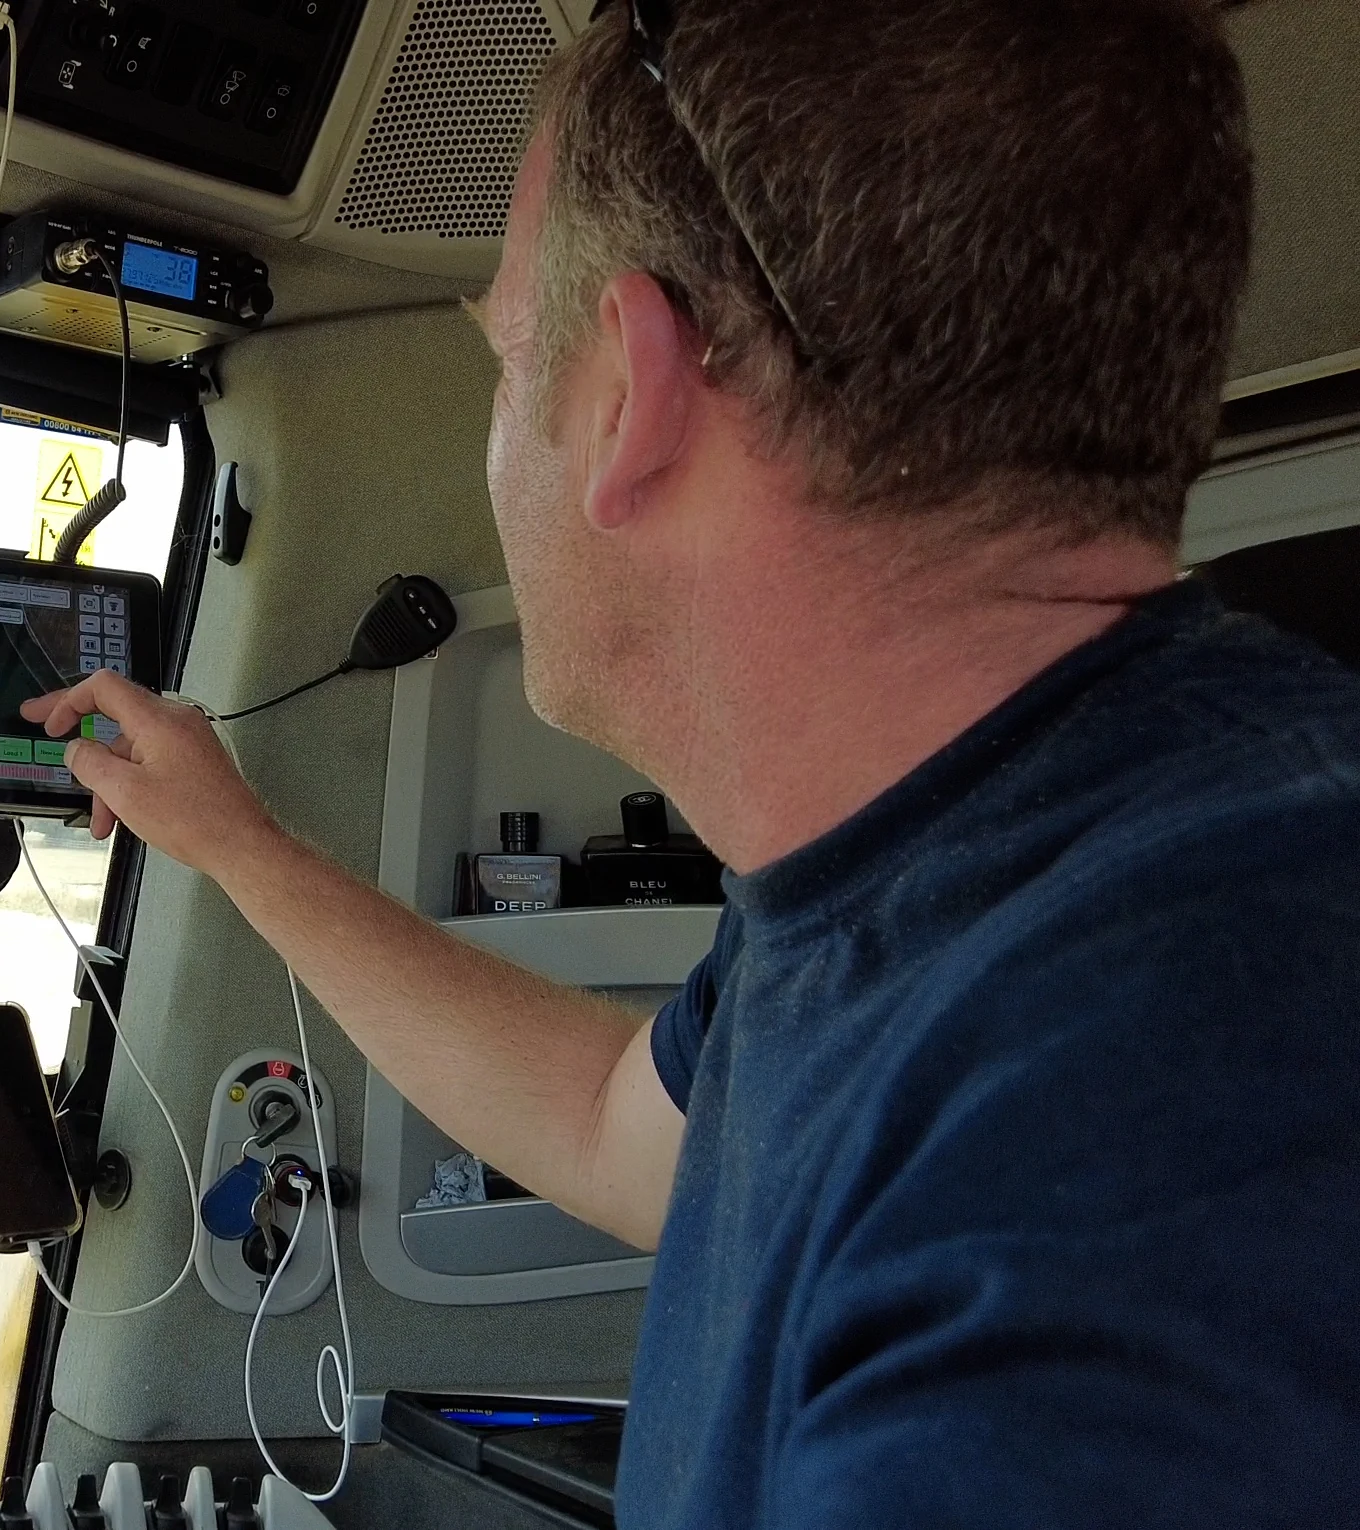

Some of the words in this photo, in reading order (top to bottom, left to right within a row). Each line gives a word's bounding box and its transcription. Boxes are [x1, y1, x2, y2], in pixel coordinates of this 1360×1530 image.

[126, 233, 163, 248] THUNDERPOLE
[164, 256, 193, 285] 38
[628, 880, 667, 889] BLEU
[494, 900, 547, 912] DEEP
